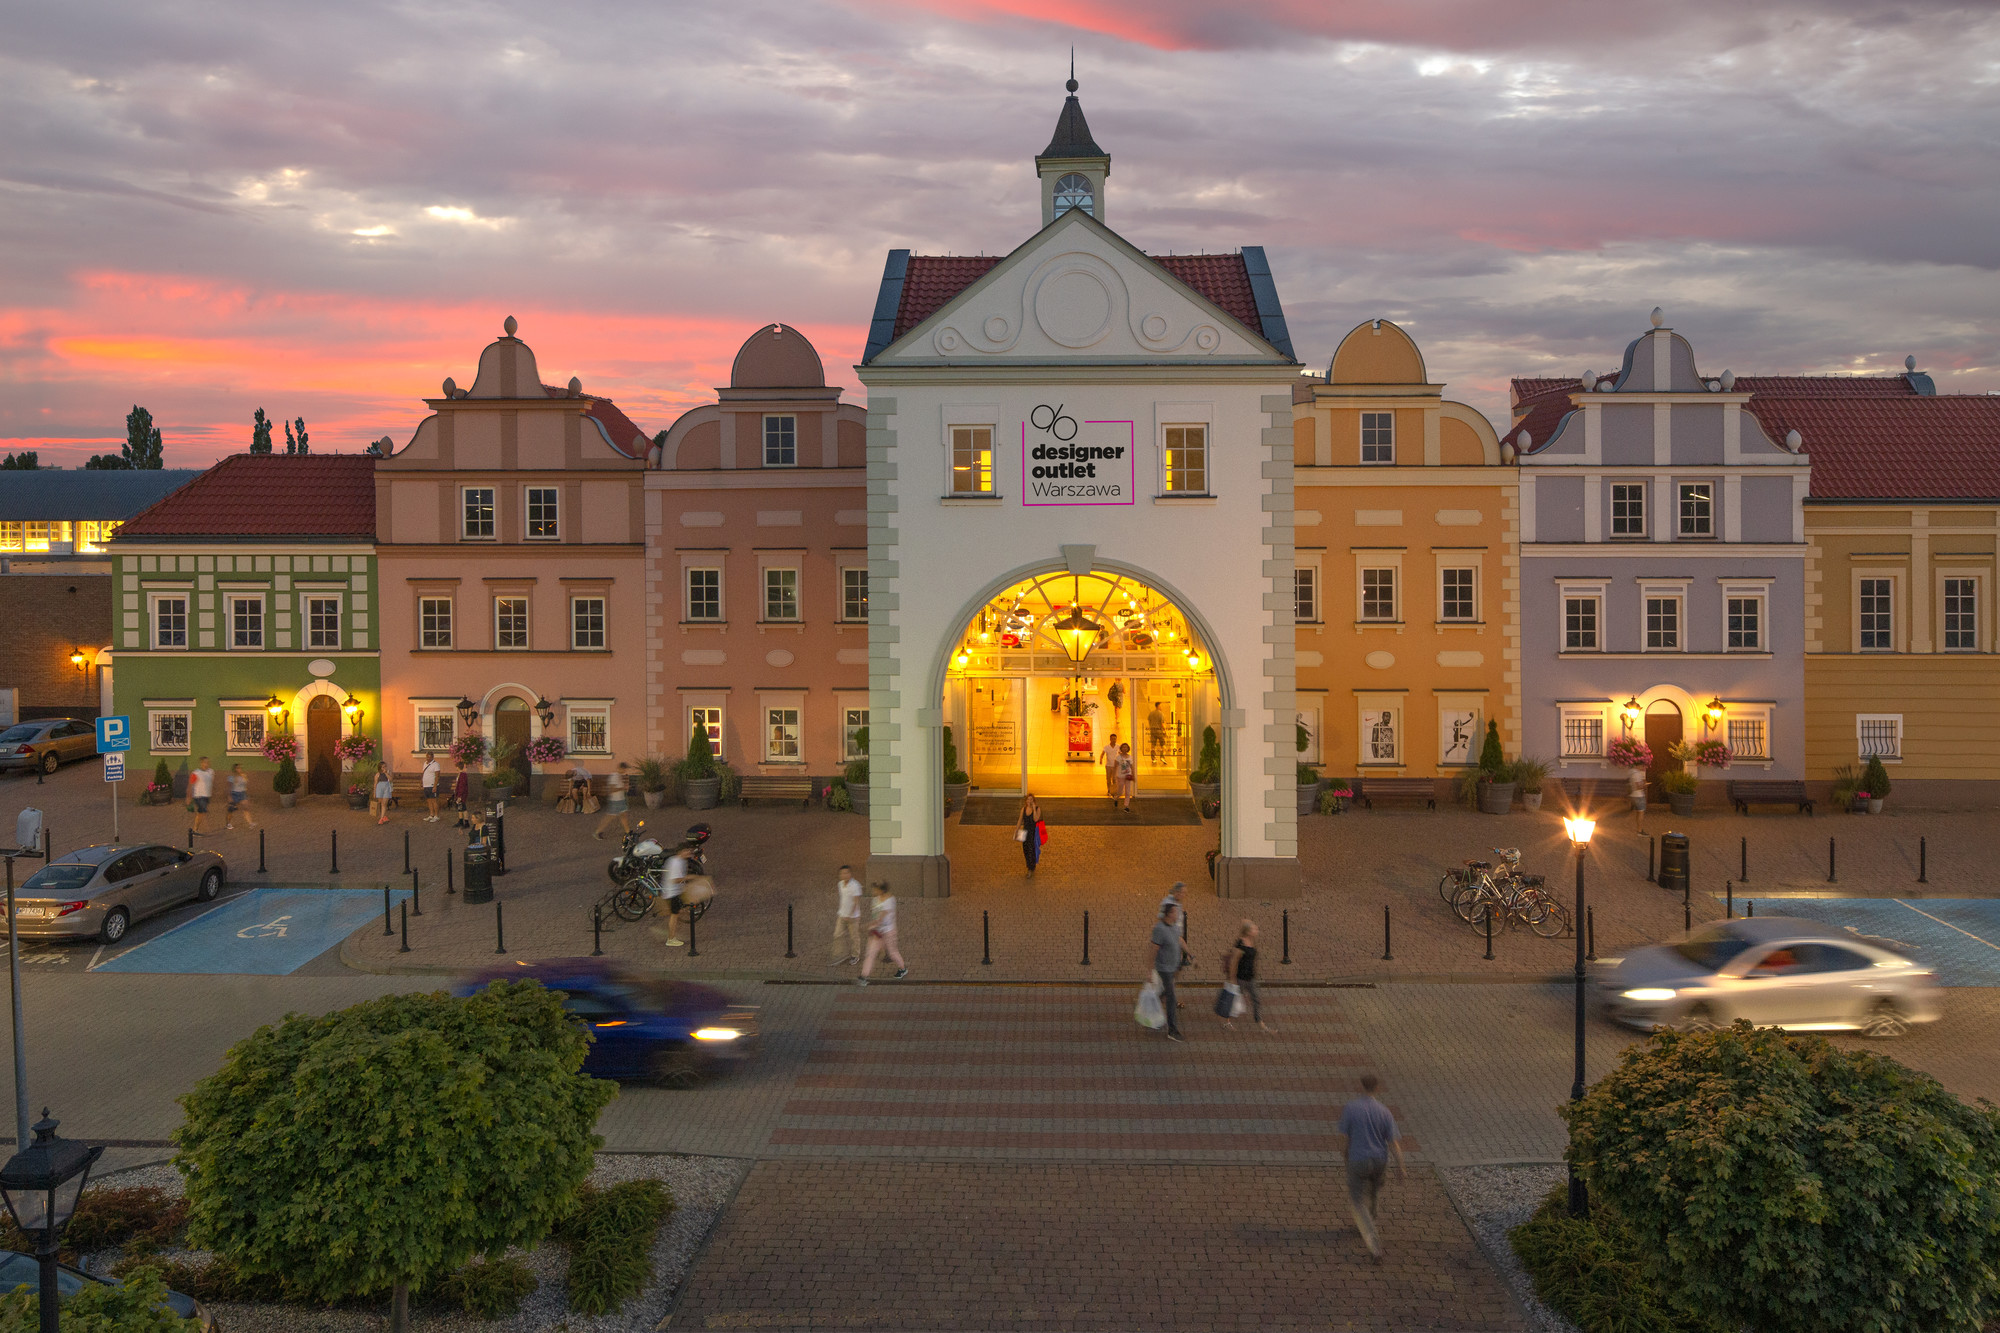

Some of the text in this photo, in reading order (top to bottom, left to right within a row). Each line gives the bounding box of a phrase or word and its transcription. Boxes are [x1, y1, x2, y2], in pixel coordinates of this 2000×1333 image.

[1032, 444, 1124, 462] designer
[1032, 462, 1095, 478] outlet
[1032, 482, 1120, 497] Warszawa
[104, 719, 123, 742] P
